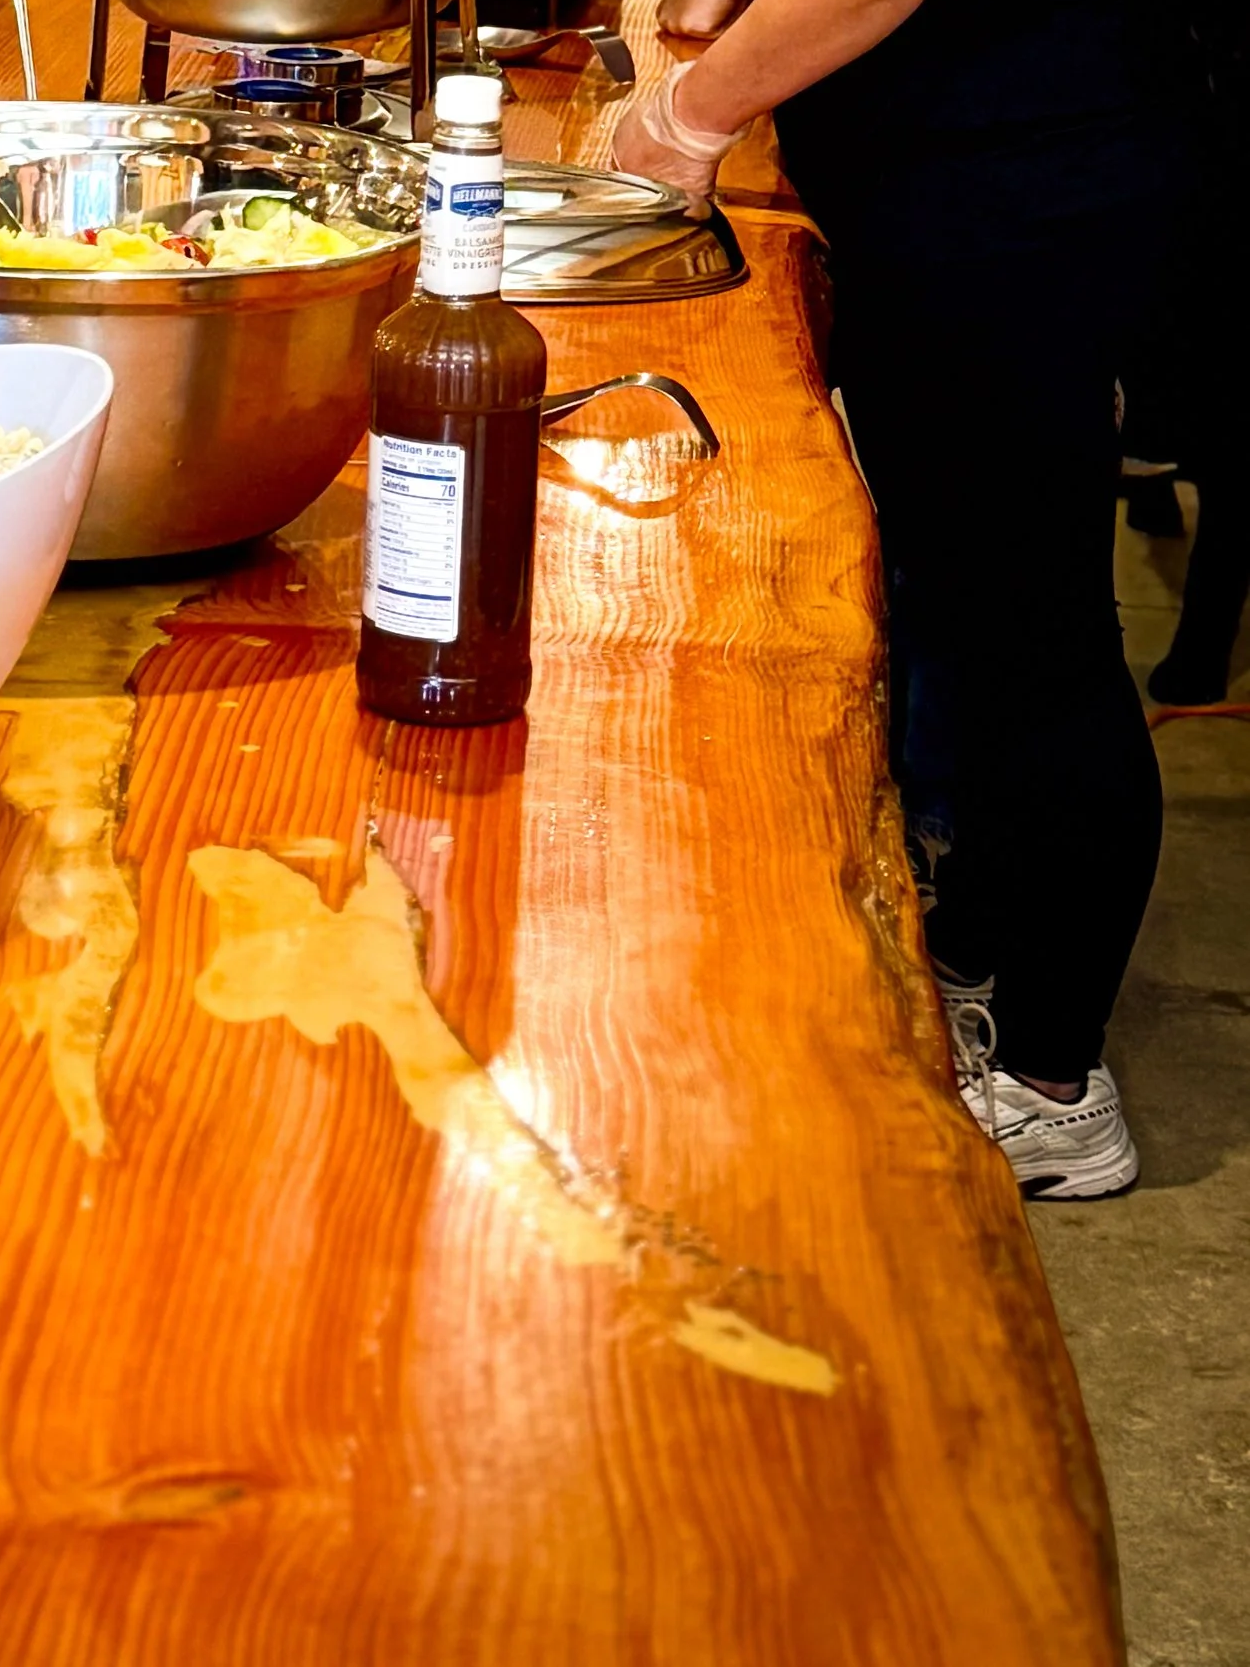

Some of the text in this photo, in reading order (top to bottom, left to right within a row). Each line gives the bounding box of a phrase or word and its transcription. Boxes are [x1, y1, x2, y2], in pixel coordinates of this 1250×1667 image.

[383, 438, 457, 458] Nutrition Facts
[382, 476, 410, 493] Calories
[440, 484, 456, 498] 70
